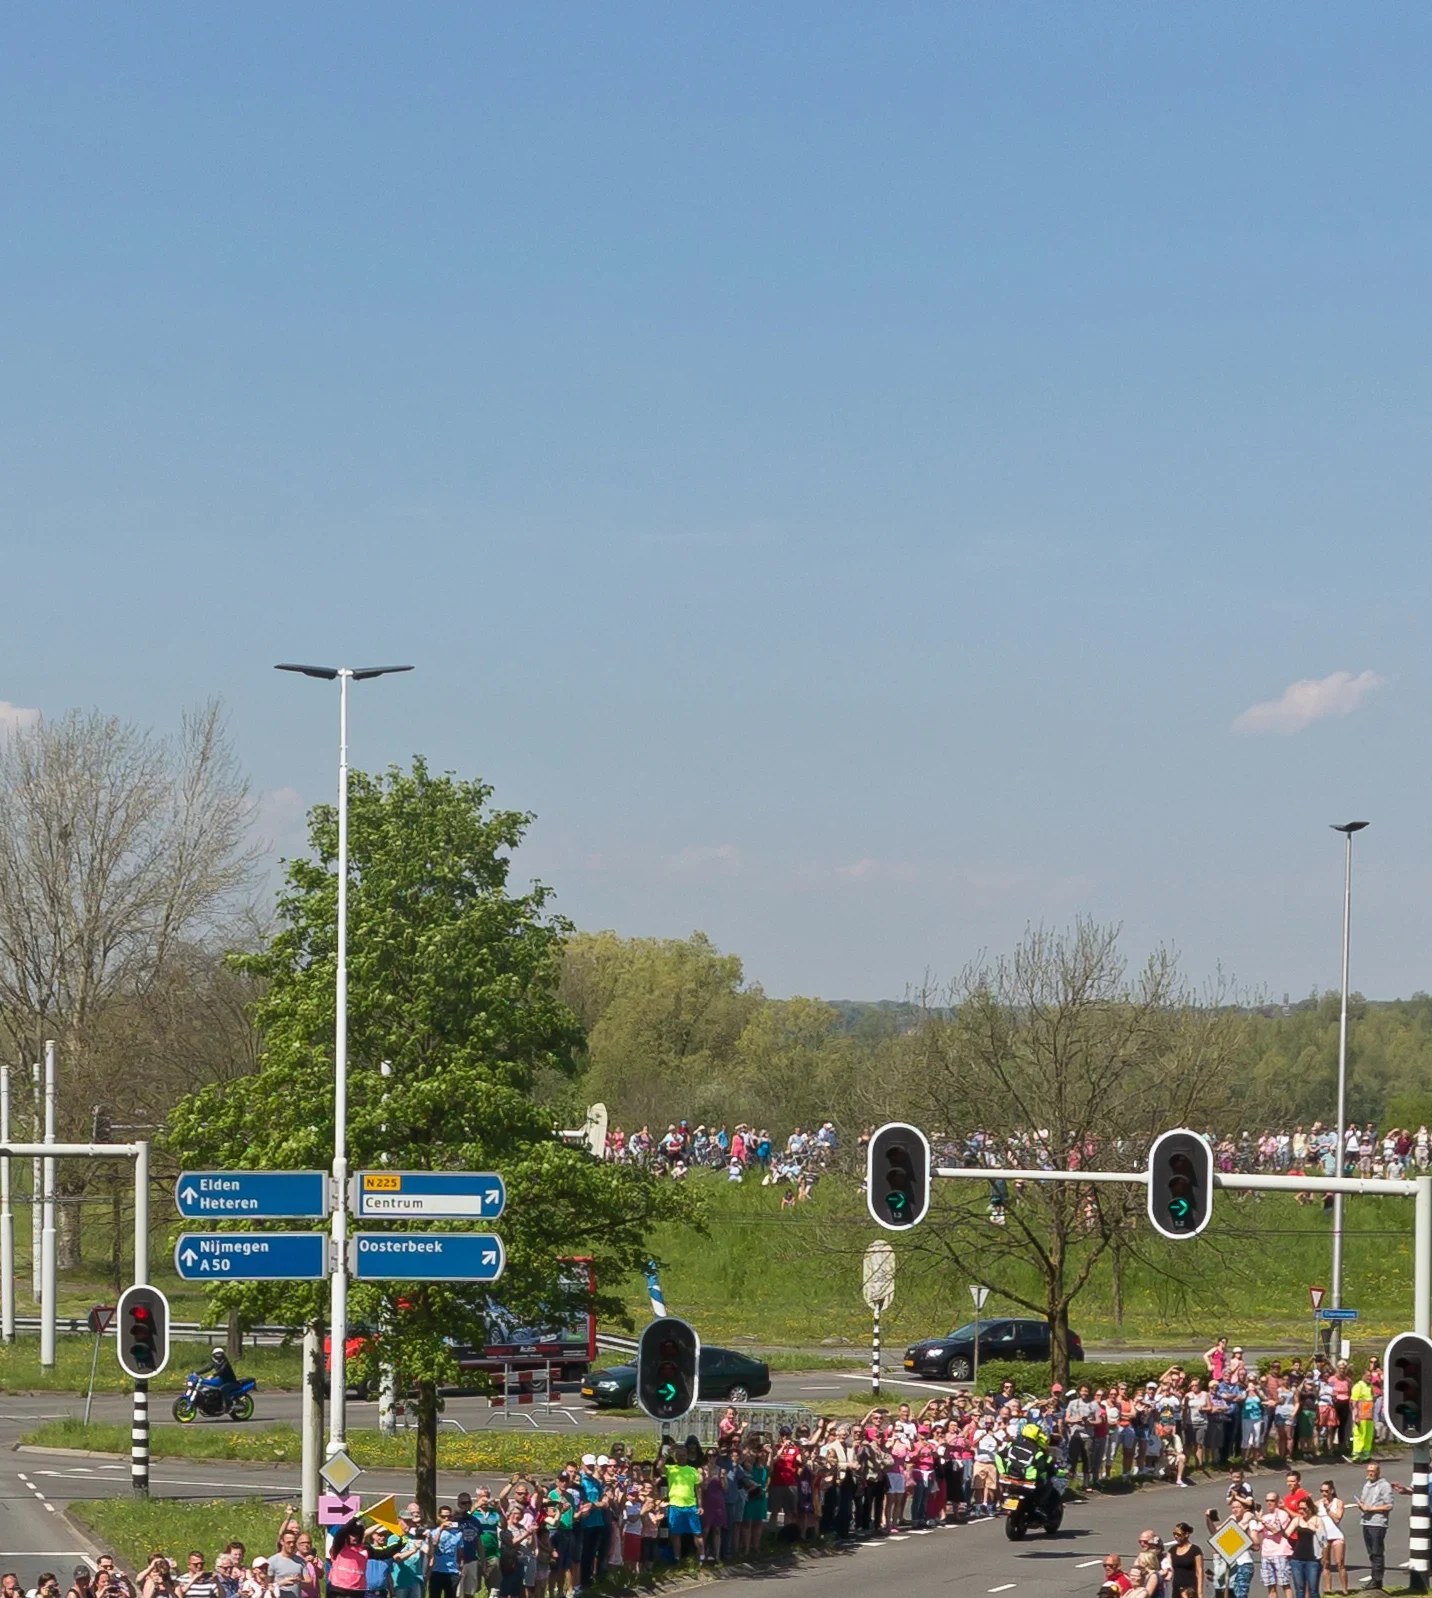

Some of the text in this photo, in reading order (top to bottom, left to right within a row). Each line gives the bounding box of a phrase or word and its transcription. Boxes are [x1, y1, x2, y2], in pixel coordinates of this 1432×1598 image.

[200, 1179, 239, 1191] Elden
[366, 1178, 397, 1188] N 225
[200, 1198, 258, 1209] Heteren
[366, 1197, 424, 1208] Centrum
[200, 1240, 269, 1255] Nijmegen
[359, 1240, 443, 1253] Oosterbeek
[212, 1259, 230, 1271] 50
